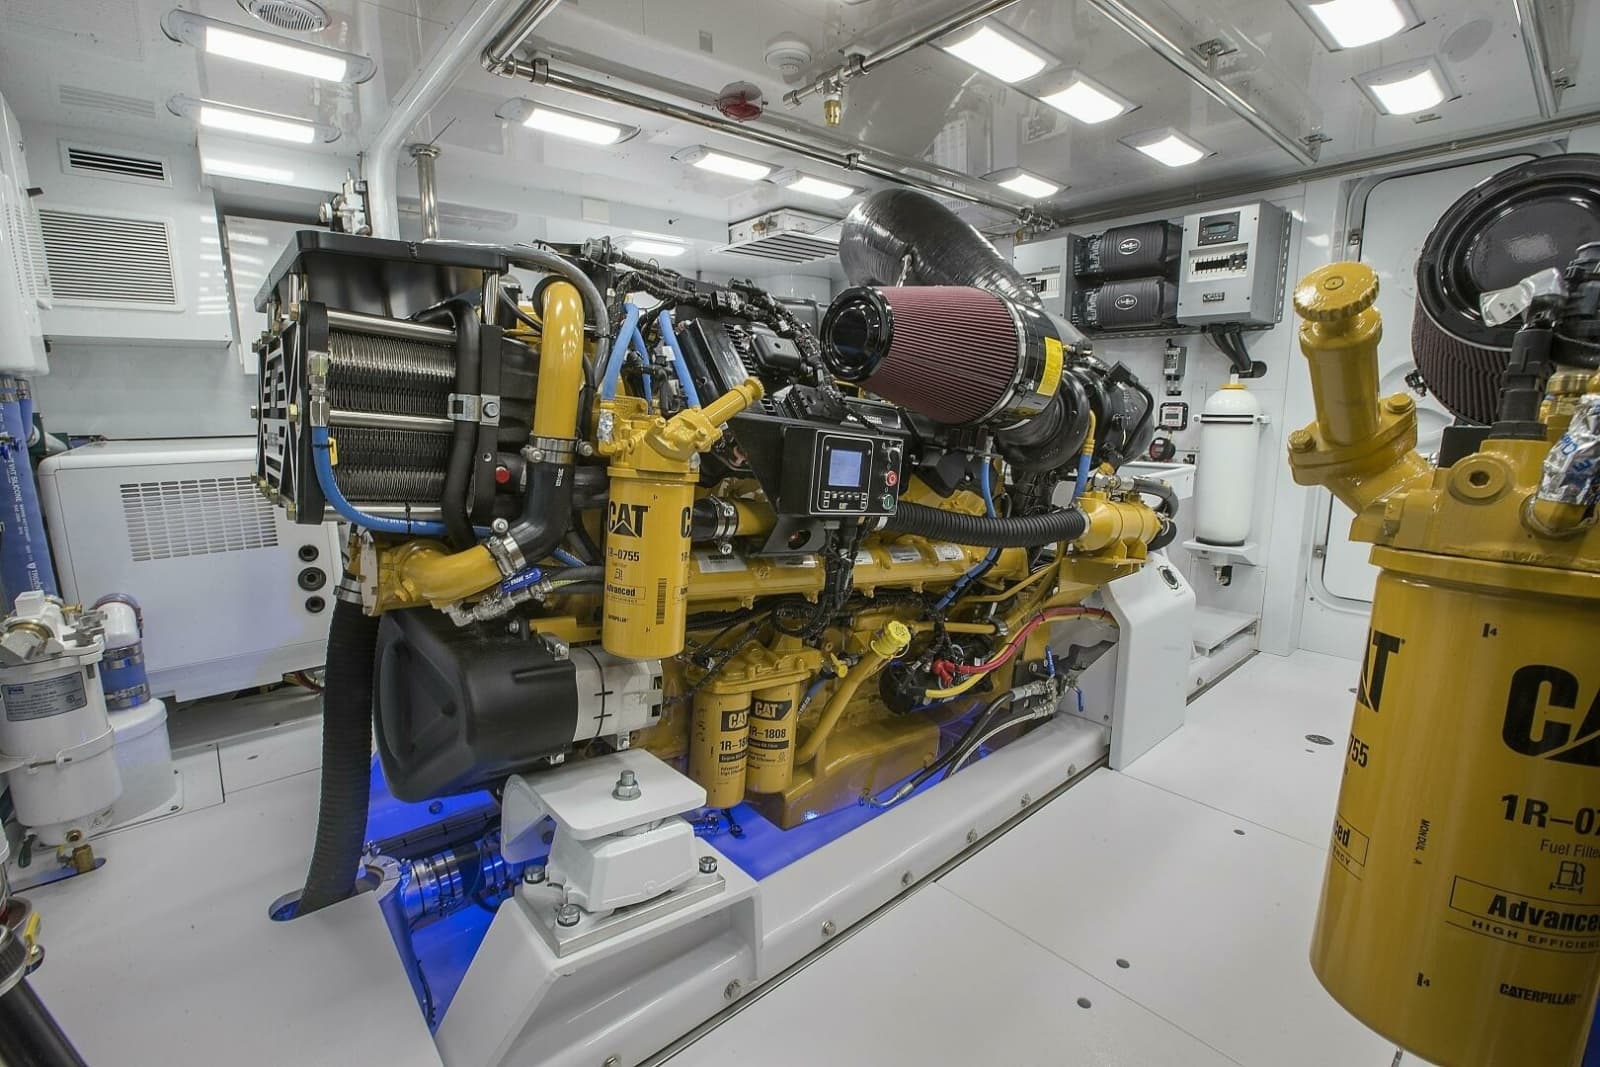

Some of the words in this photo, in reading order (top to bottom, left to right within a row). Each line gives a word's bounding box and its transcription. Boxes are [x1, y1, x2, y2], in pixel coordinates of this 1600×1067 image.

[608, 500, 649, 538] CAT
[755, 702, 778, 718] CAT
[1540, 838, 1570, 857] Fuel
[1471, 919, 1519, 940] HIGH
[1500, 982, 1577, 1007] CATERPILLAR
